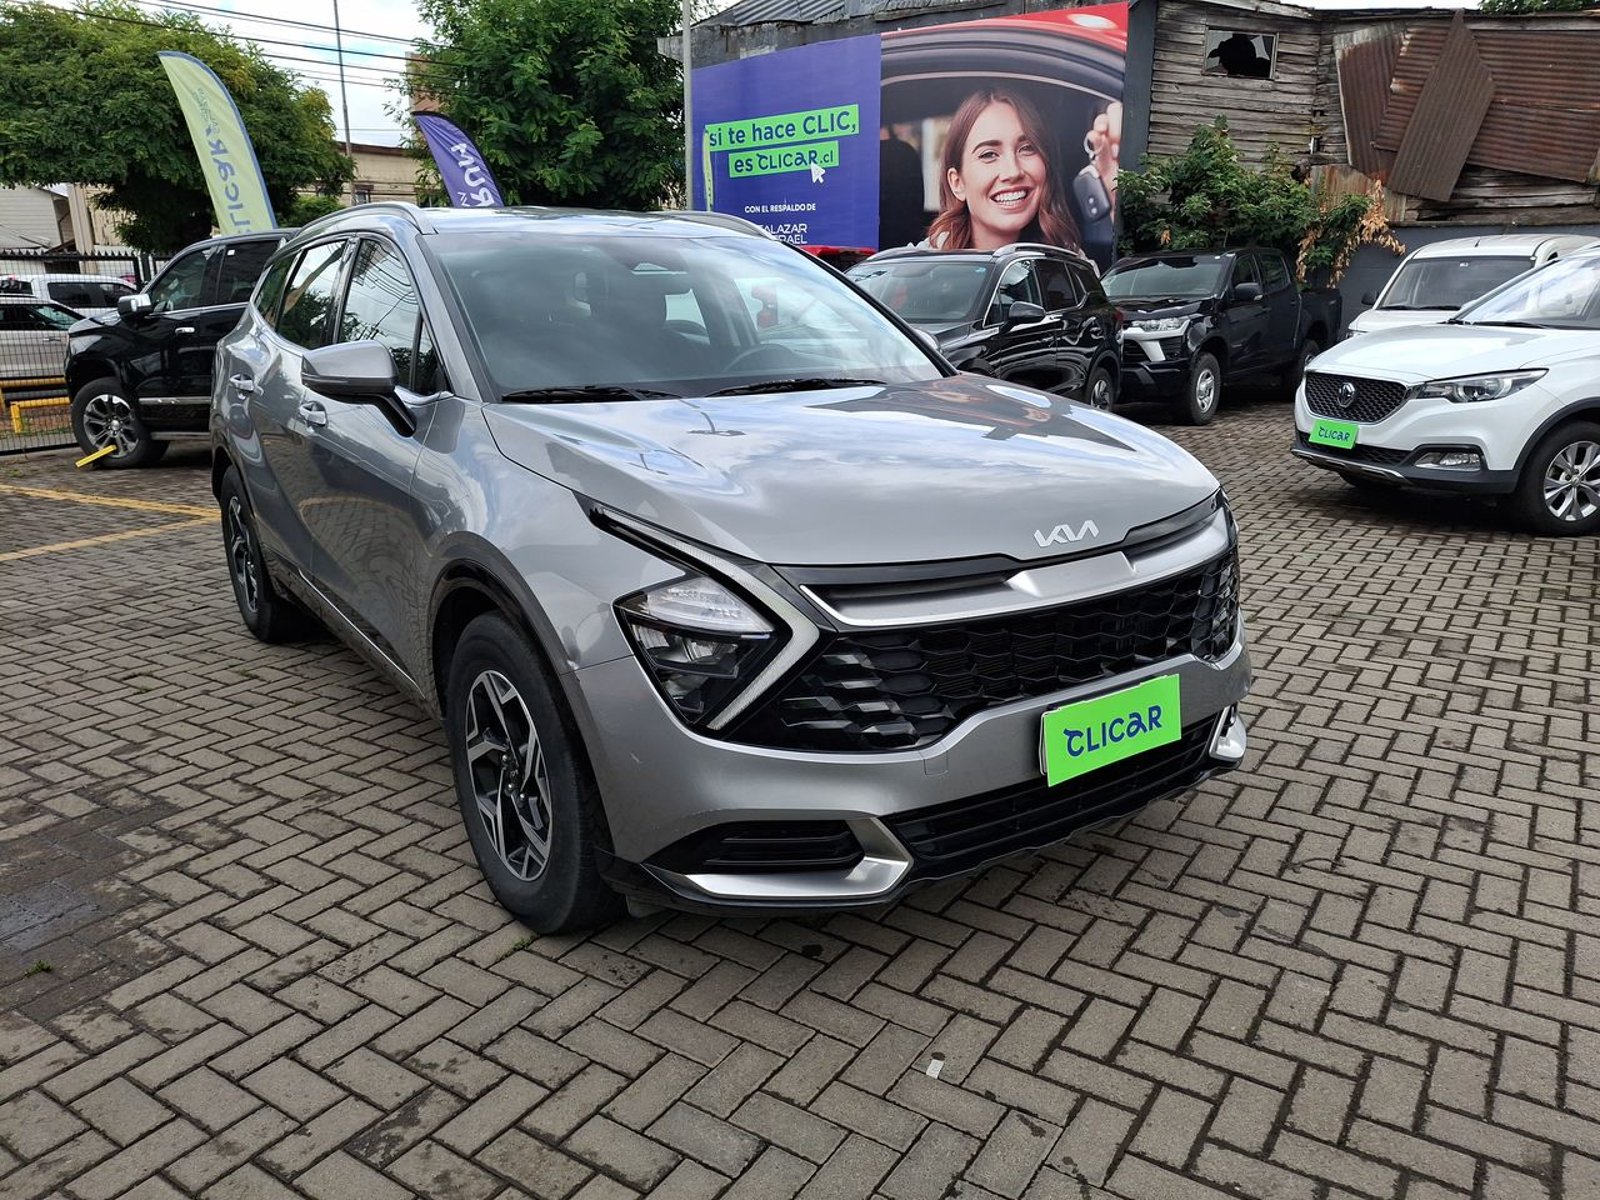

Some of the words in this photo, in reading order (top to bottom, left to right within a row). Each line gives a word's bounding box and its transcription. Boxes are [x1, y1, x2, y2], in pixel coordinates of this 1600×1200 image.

[709, 128, 722, 147] si
[728, 126, 746, 144] te
[751, 123, 796, 142] hace
[802, 110, 857, 133] CLIC,
[734, 157, 753, 173] es
[744, 205, 761, 214] CON
[761, 204, 769, 213] EL
[769, 203, 806, 212] RESPALDO
[806, 202, 817, 211] DE
[774, 234, 808, 245] RAEL
[1033, 519, 1100, 548] KIA
